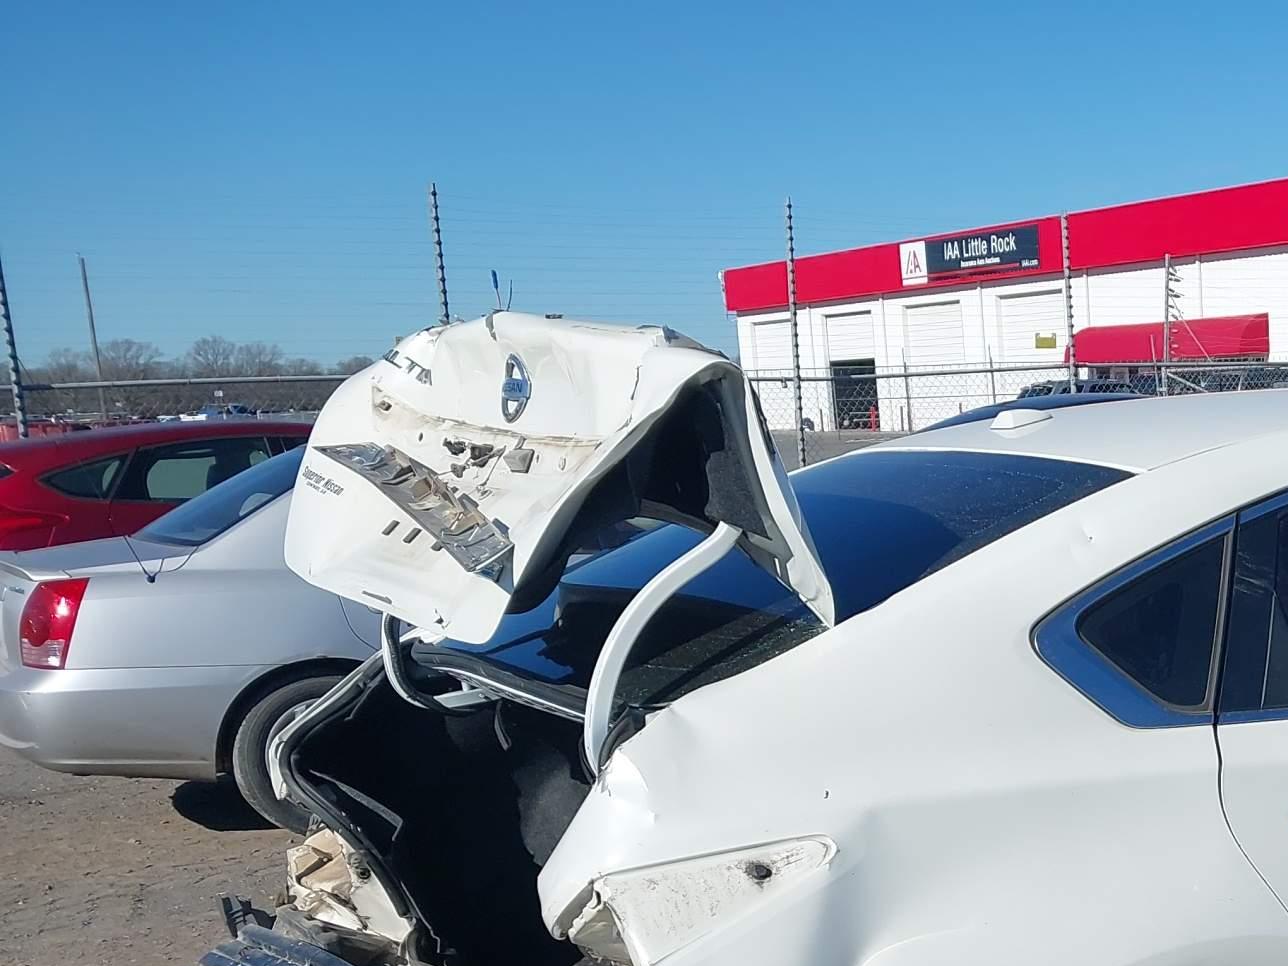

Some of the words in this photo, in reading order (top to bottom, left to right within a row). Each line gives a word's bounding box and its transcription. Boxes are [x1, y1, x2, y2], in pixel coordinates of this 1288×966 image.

[943, 241, 960, 260] IAA
[962, 237, 988, 258] Little
[990, 232, 1017, 254] Rock
[302, 465, 325, 485] Superior
[322, 479, 344, 496] Nissan
